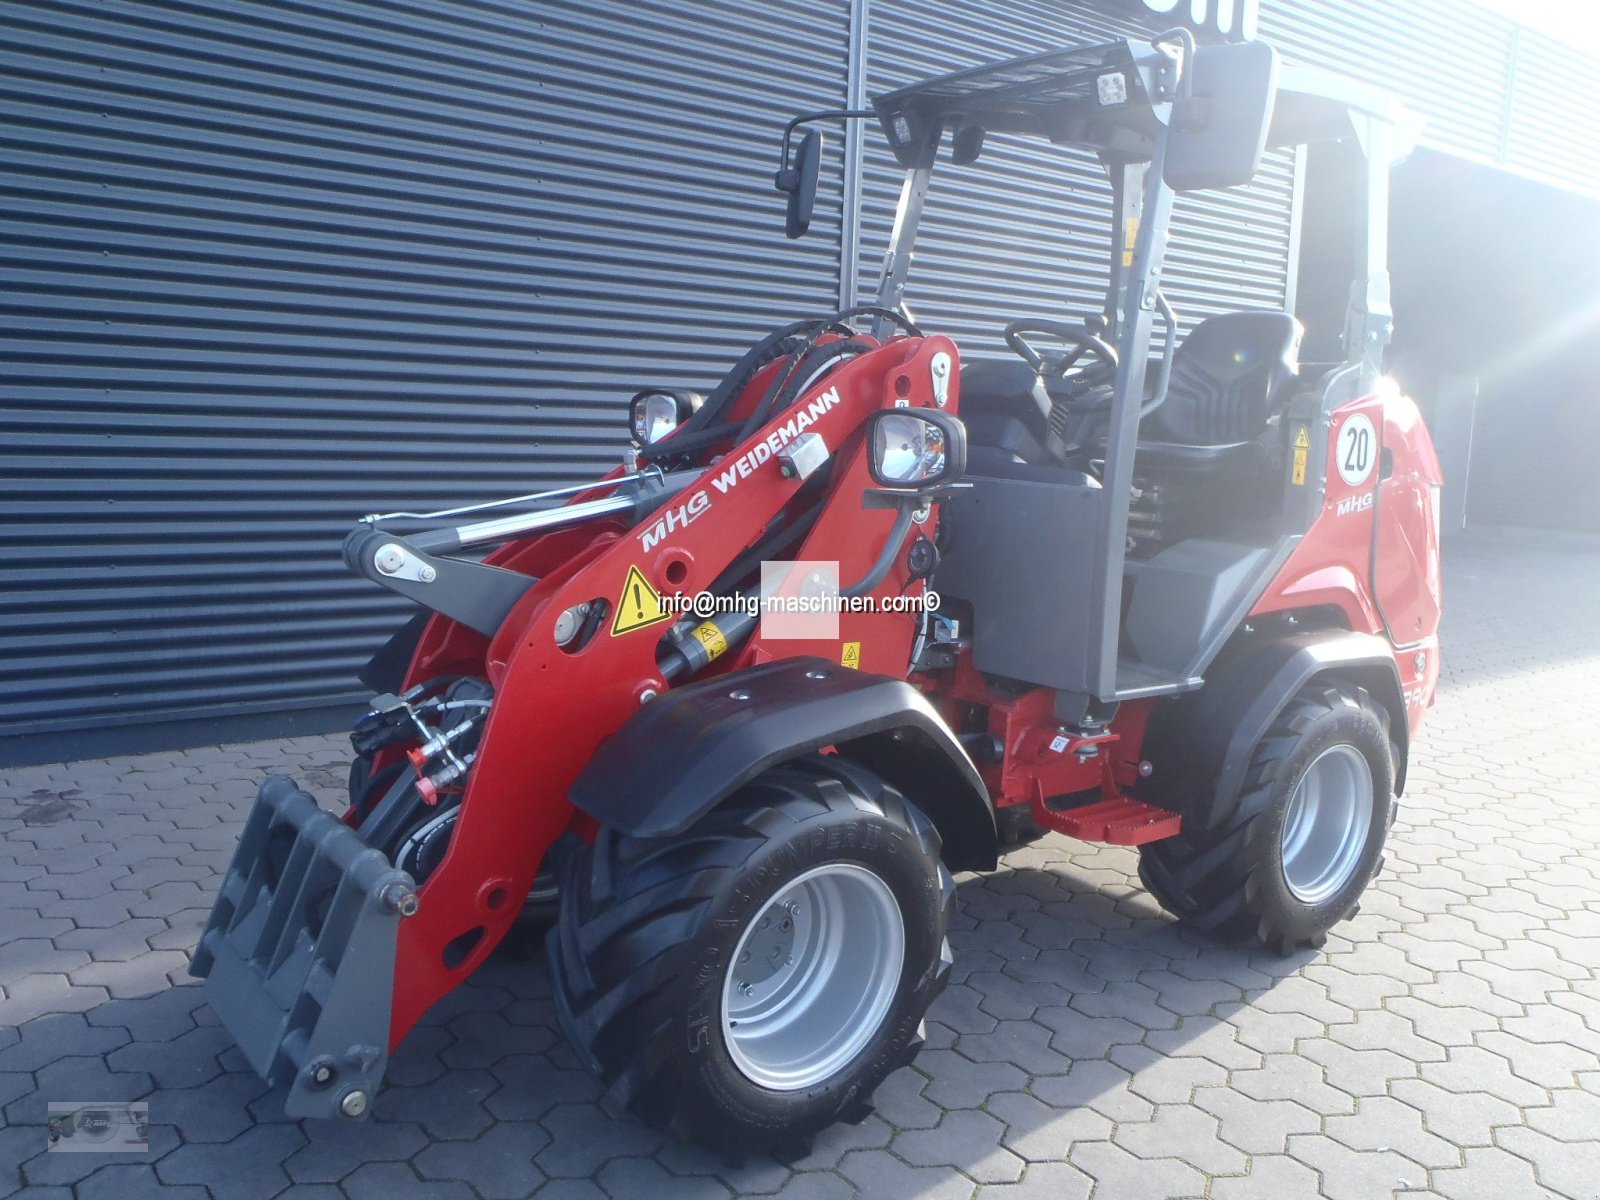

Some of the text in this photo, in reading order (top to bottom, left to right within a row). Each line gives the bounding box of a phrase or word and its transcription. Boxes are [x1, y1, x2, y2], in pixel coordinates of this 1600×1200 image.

[637, 386, 841, 552] MHG WEIDEMANN
[1344, 427, 1369, 472] 20
[1336, 492, 1373, 517] MHG
